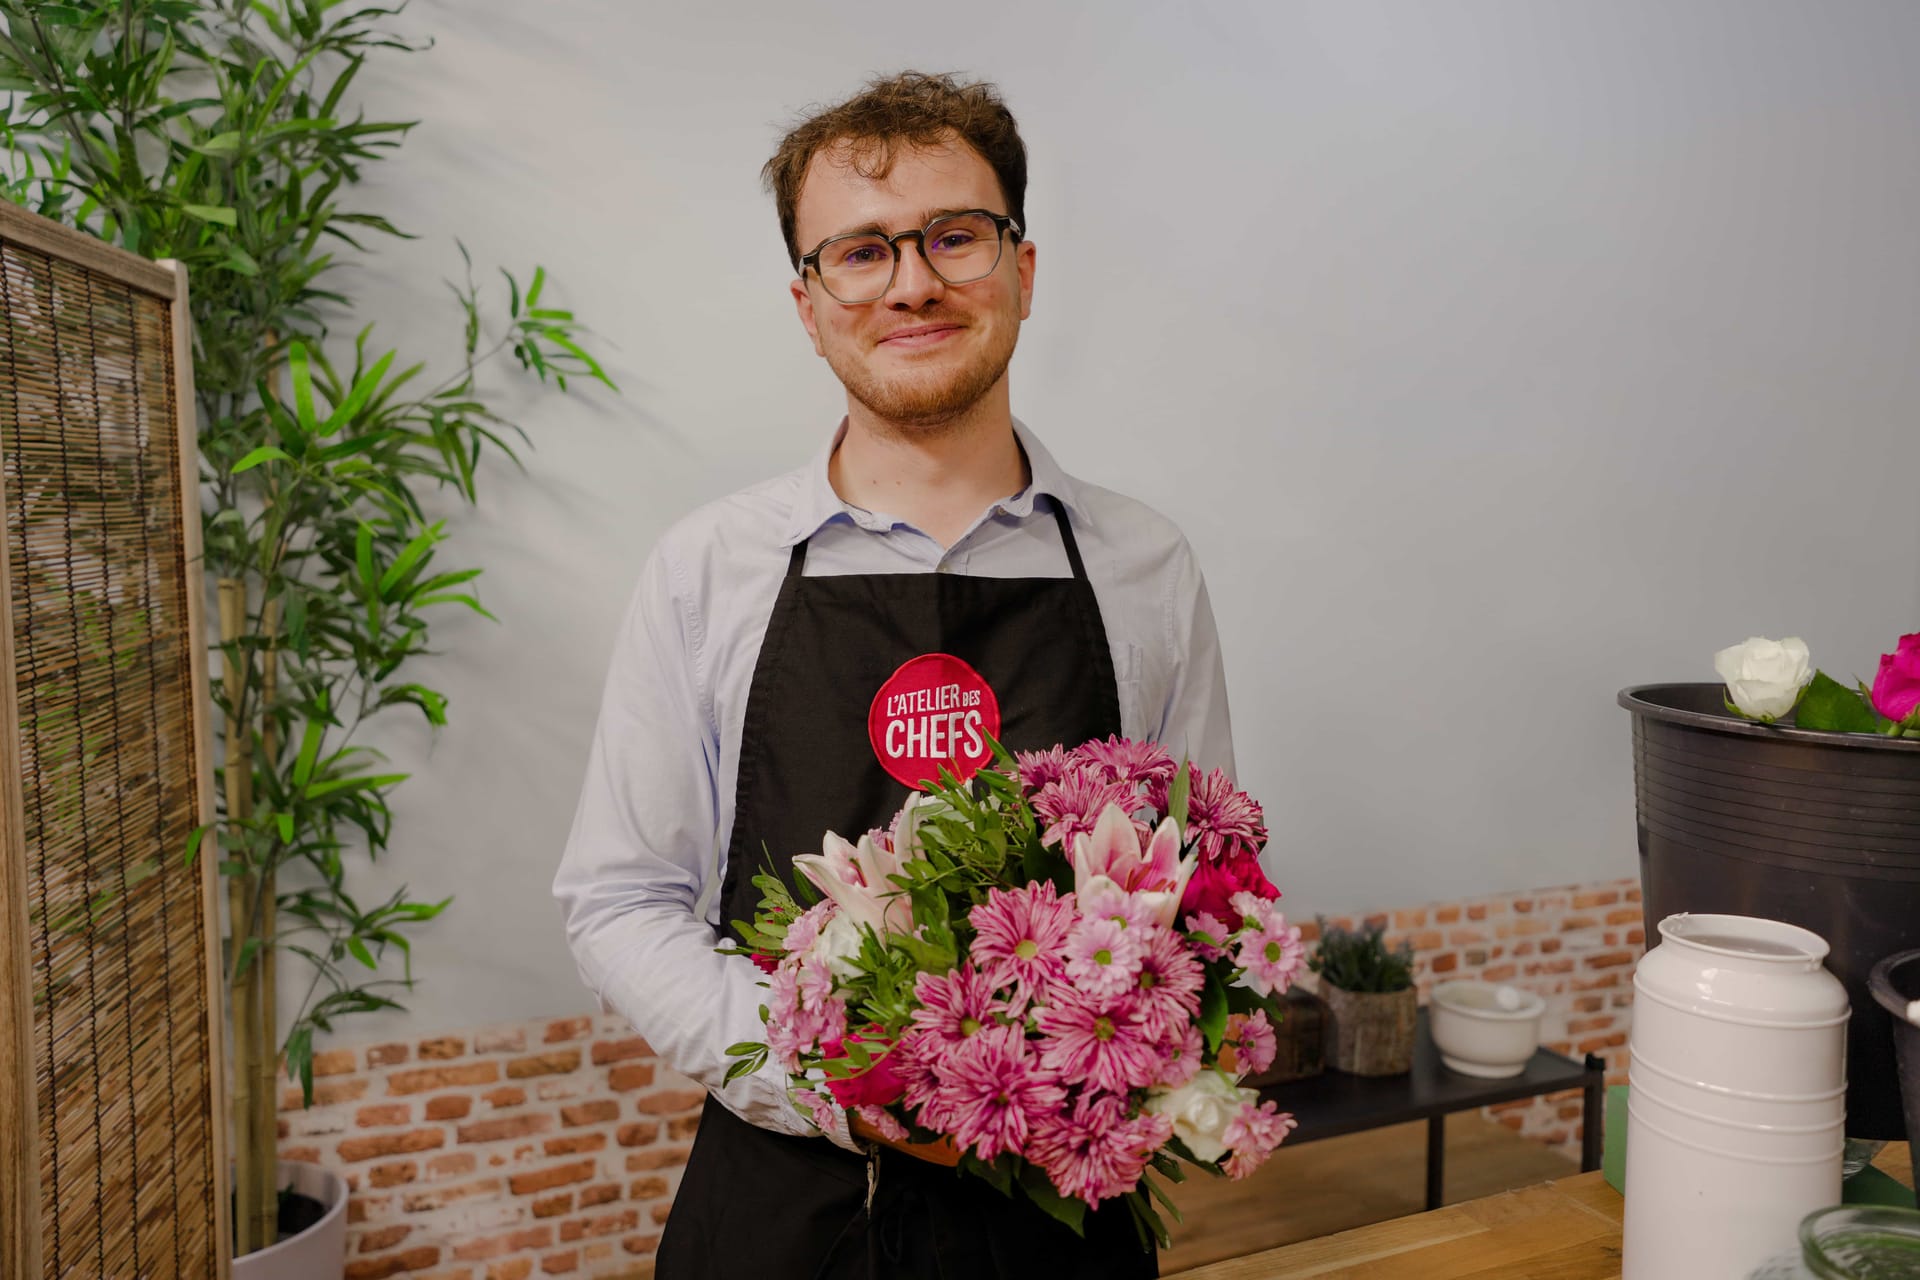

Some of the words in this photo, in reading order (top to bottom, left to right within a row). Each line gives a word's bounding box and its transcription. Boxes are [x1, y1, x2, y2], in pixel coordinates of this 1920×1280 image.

[886, 683, 961, 717] L'ATELIER
[962, 689, 981, 707] DES
[885, 709, 984, 759] CHEFS
